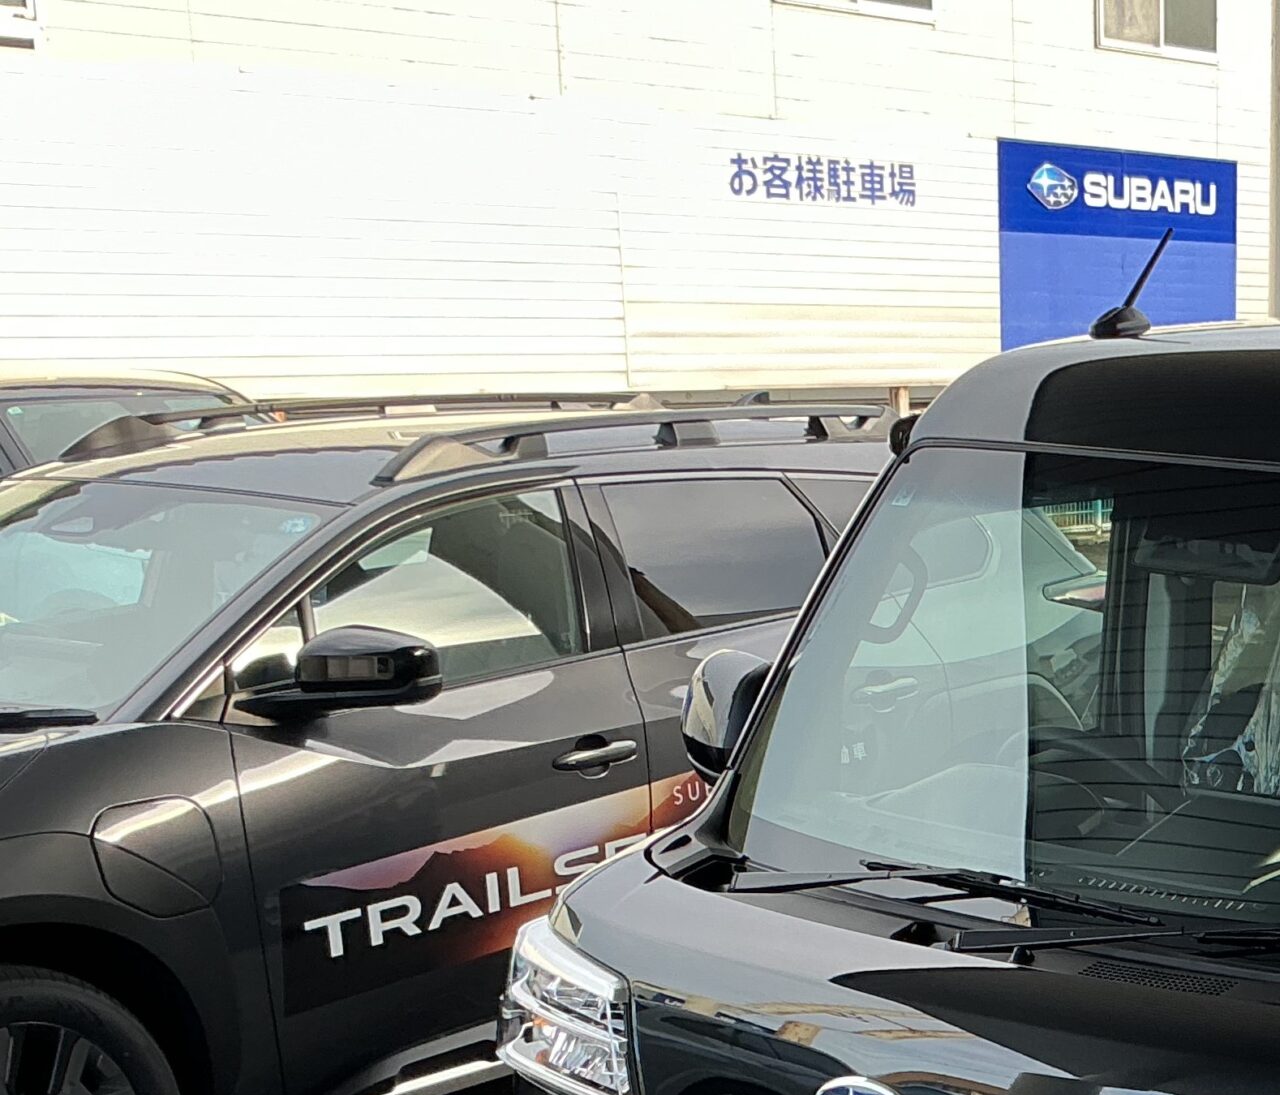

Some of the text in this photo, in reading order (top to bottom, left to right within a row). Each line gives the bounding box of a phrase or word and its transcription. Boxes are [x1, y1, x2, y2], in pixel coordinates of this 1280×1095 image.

[730, 152, 916, 207] お客様駐車場
[1083, 171, 1217, 215] SUBARU
